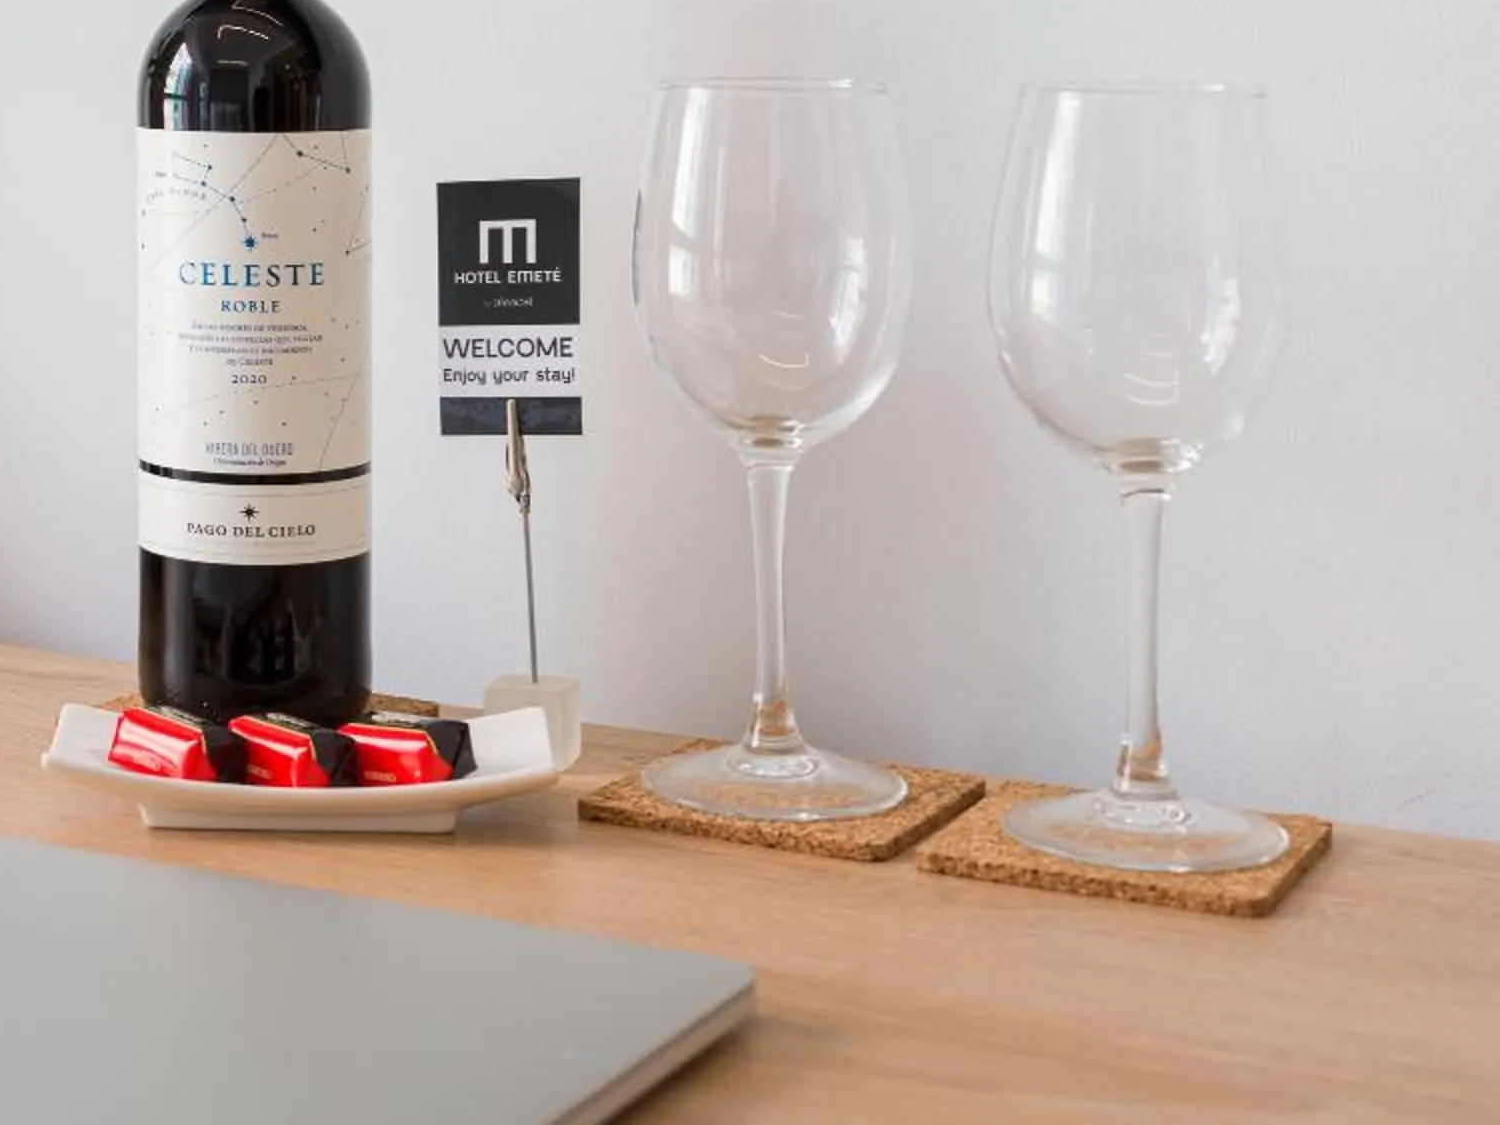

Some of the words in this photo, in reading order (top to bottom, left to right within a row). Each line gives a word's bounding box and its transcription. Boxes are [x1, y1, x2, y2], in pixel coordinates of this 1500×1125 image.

[179, 262, 325, 287] CELESTE
[454, 272, 502, 284] HOTEL
[220, 299, 282, 314] ROBLE
[443, 337, 574, 359] WELCOME
[231, 374, 268, 384] 2020
[443, 368, 487, 385] Enjoy
[493, 370, 529, 384] your
[535, 366, 576, 384] stay!
[187, 522, 227, 536] PAGO
[232, 526, 265, 538] DEL
[267, 524, 316, 538] CIELO
